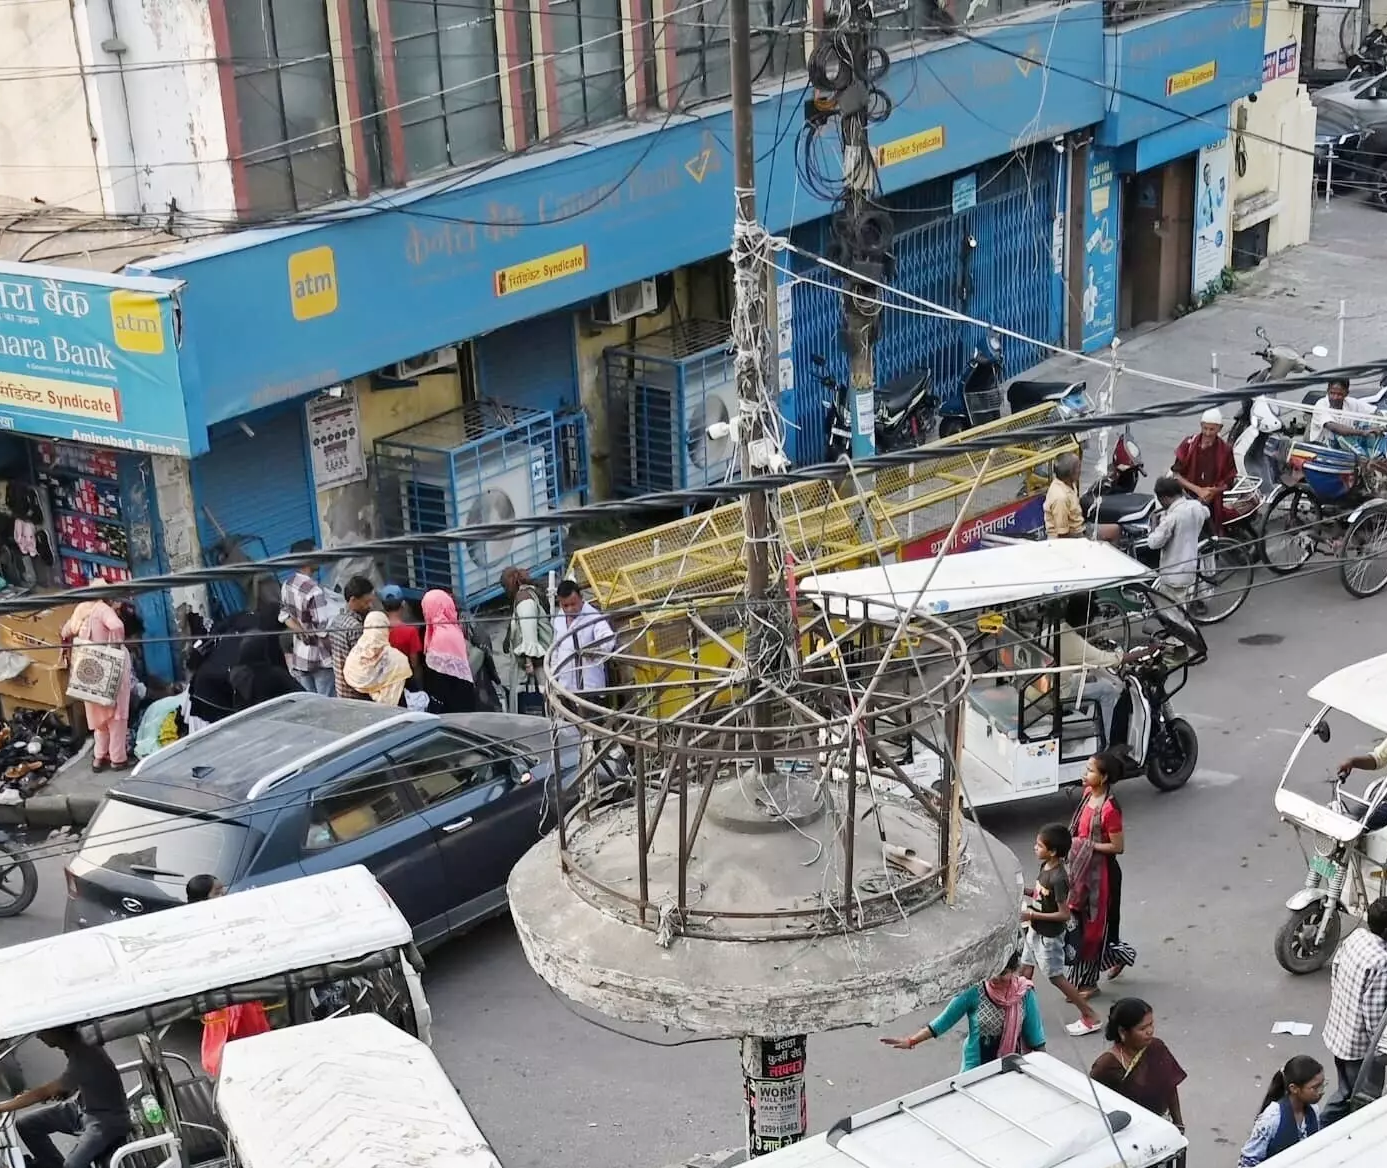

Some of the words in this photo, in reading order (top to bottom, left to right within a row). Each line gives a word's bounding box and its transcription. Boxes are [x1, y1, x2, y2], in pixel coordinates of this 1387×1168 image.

[542, 255, 584, 279] Syndicate
[294, 271, 334, 299] atm
[43, 279, 90, 318] बैंक
[115, 312, 160, 335] atm
[52, 335, 117, 370] Bank
[48, 389, 113, 413] Syndicate
[72, 429, 134, 453] Aminabad
[961, 511, 1017, 544] अमीनाबाद
[760, 1086, 796, 1097] WORK
[761, 1105, 778, 1113] PART
